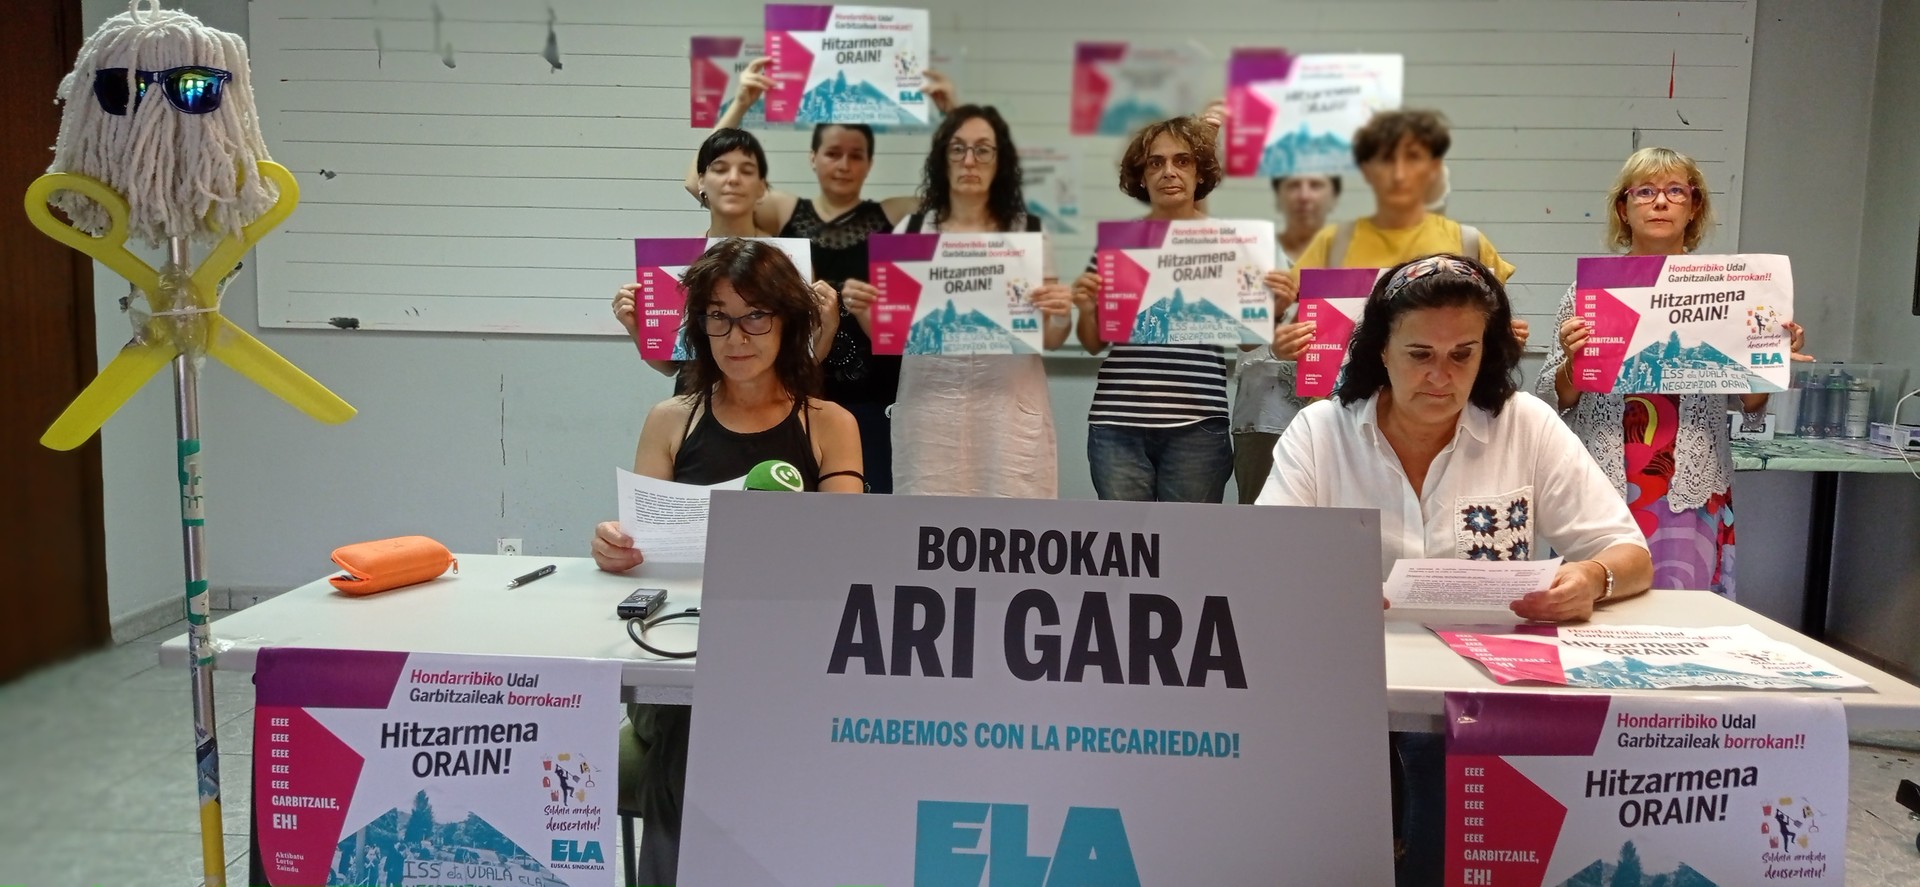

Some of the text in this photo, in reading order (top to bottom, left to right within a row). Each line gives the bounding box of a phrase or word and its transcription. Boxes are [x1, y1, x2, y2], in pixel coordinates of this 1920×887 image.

[822, 36, 893, 51] Hitzarmena
[836, 50, 881, 64] ORAIN!
[1158, 251, 1236, 268] Hitzarmena
[929, 264, 1004, 281] Hitzarmena
[1173, 265, 1222, 282] ORAIN!
[1668, 263, 1746, 273] Hondarribiko Udal
[1668, 273, 1772, 283] Garbitzaileak borrokan!!
[945, 278, 992, 294] ORAIN!
[1650, 290, 1745, 309] Hitzarmena
[1242, 308, 1268, 319] ELA
[1669, 305, 1729, 324] ORAIN!
[646, 319, 659, 327] EH!
[1012, 318, 1038, 329] ELA
[1306, 353, 1320, 362] EH!
[1584, 347, 1599, 356] EH!
[1751, 353, 1783, 364] ELA
[1662, 369, 1684, 379] ISS
[1698, 369, 1728, 379] UDALA
[1662, 380, 1749, 391] NEGOZIAZIOA ORAIN
[917, 526, 1160, 579] BORROKAN
[826, 583, 1249, 690] ARI GARA
[1561, 639, 1709, 649] Hitzarmena
[1603, 648, 1699, 656] ORAIN!
[410, 669, 539, 688] Hondarribiko Udal
[409, 688, 582, 709] Garbitzaileak borrokan!!
[271, 718, 289, 727] EEEE
[1617, 713, 1756, 729] Hondarribiko Udal
[271, 733, 289, 742] EEEE
[380, 721, 539, 749] Hitzarmena
[831, 717, 1240, 760] ¡ACABEMOS CON LA PRECARIEDAD!
[1617, 732, 1805, 750] Garbitzaileak borrokan!!
[271, 749, 289, 758] EEEE
[271, 765, 289, 774] EEEE
[412, 748, 512, 778] ORAIN!
[1464, 767, 1484, 777] EEEE
[271, 780, 289, 789] EEEE
[1585, 765, 1758, 798] Hitzarmena
[1464, 784, 1484, 794] EEEE
[272, 795, 340, 811] GARBITZAILE,
[1464, 800, 1484, 810] EEEE
[1618, 793, 1728, 828] ORAIN!
[273, 813, 298, 830] EH!
[546, 817, 601, 832] deuseztatu!
[1464, 817, 1484, 827] EEEE
[914, 800, 1141, 887] ELA
[1464, 833, 1484, 843] EEEE
[275, 851, 304, 860] Aktibatu
[551, 839, 605, 863] ELA
[1464, 849, 1539, 864] GARBITZAILE,
[276, 858, 293, 866] Lortu
[276, 865, 299, 873] Zaindu
[572, 863, 605, 871] SINDIKATUA
[404, 861, 441, 879] ISS
[446, 864, 463, 881] eta
[467, 865, 513, 882] UDALA
[1463, 868, 1492, 885] EH!
[1765, 863, 1826, 879] deuseztatu!
